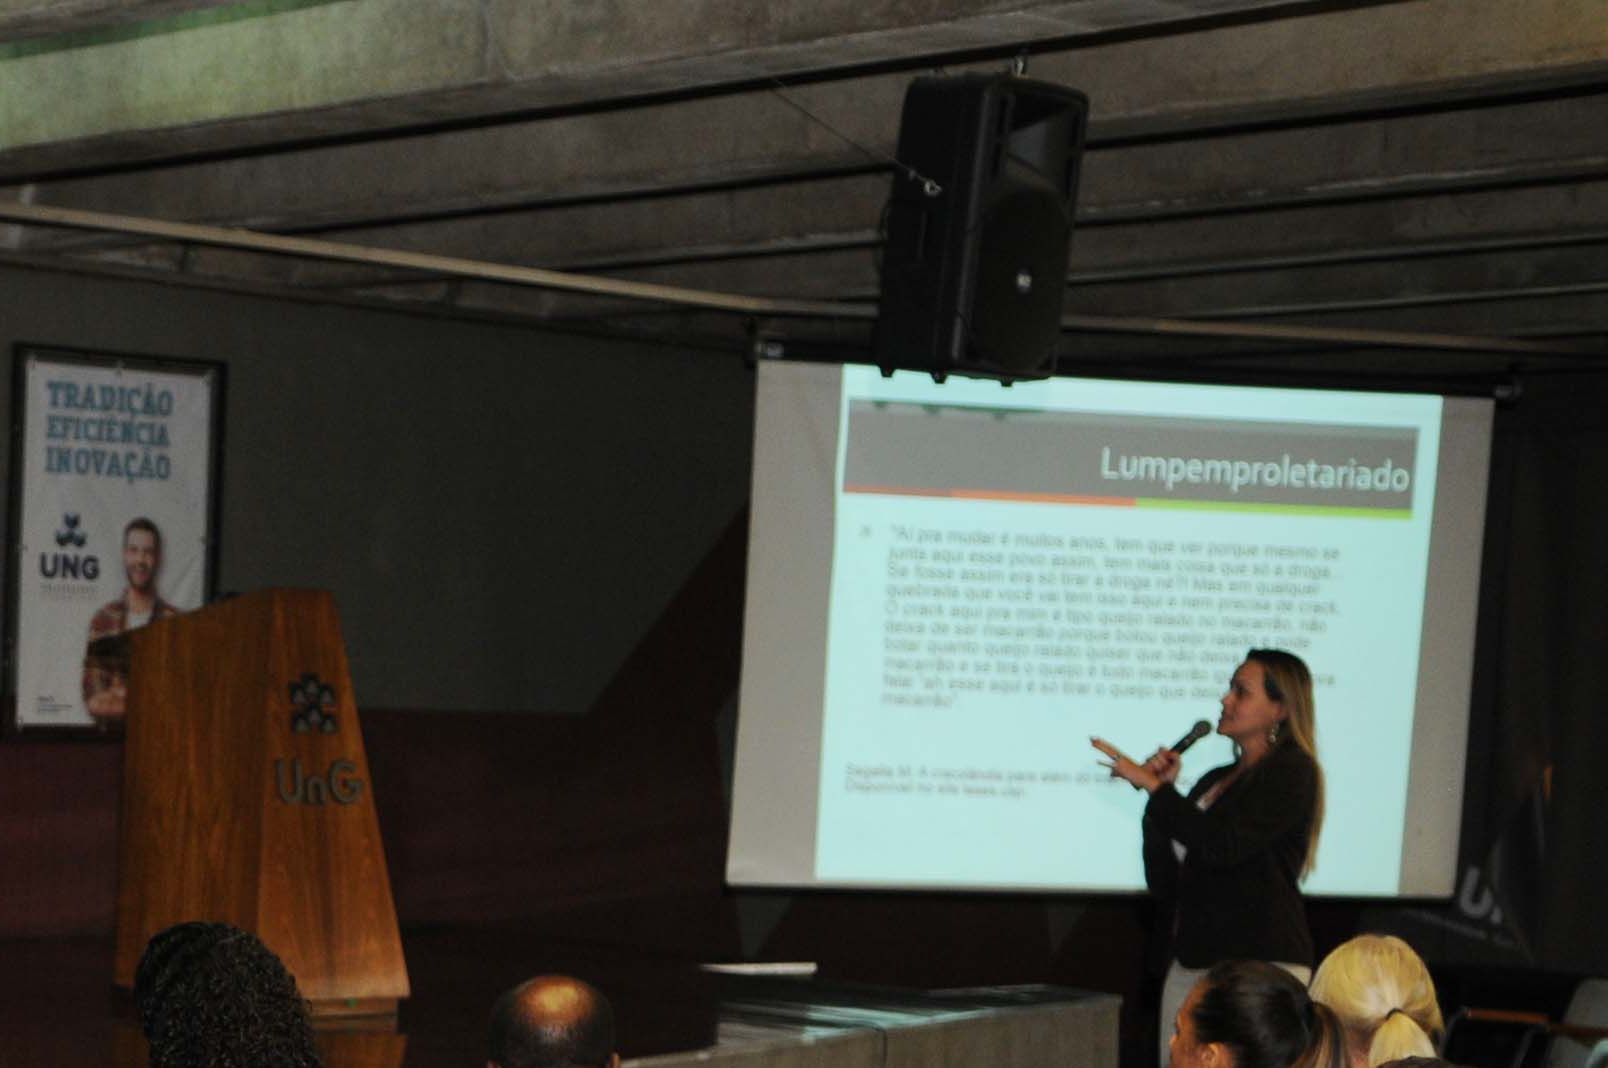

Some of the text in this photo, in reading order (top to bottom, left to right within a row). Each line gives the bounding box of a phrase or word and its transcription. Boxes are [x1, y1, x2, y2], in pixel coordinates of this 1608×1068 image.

[46, 380, 175, 418] TRADIÇÃO
[45, 414, 170, 448] EFICIÊNCIA
[44, 446, 172, 485] INOVAÇÃO
[1100, 445, 1410, 494] Lumpemproletariado
[39, 552, 100, 580] UNG
[276, 757, 362, 805] UnG
